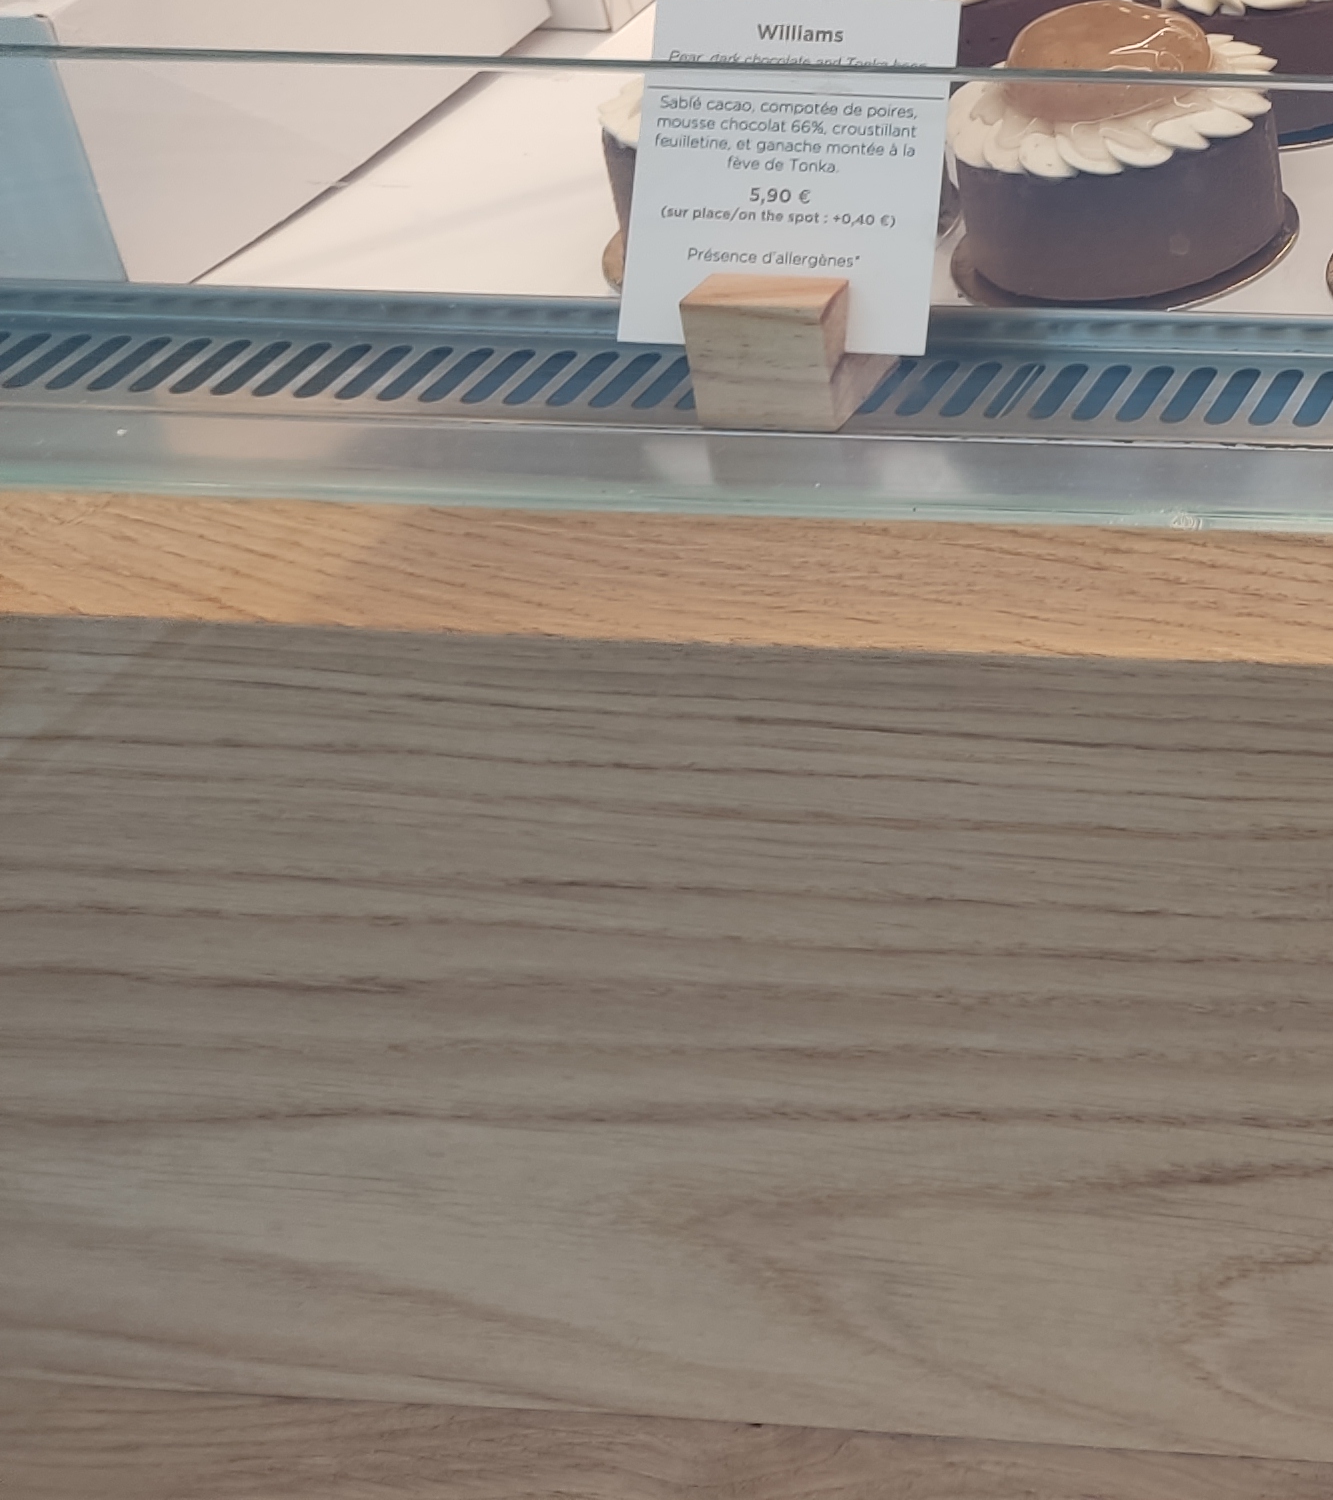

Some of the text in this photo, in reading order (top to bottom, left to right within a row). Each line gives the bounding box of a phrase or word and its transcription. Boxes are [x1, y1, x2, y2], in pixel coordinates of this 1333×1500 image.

[757, 24, 844, 43] Williams
[660, 95, 917, 119] Sablé cacao, compotée de poires,
[657, 116, 917, 138] mousse chocolat 66%, croustillant
[655, 135, 915, 158] feuilletine, et ganache montée à la
[727, 156, 839, 173] fève de Tonka.
[750, 188, 811, 205] 5,90 €
[661, 206, 689, 220] (sur
[693, 207, 756, 222] place/on
[761, 210, 783, 222] the
[788, 212, 820, 225] spot
[833, 214, 875, 228] +0,40
[880, 214, 895, 228] €)
[688, 248, 757, 264] Présence
